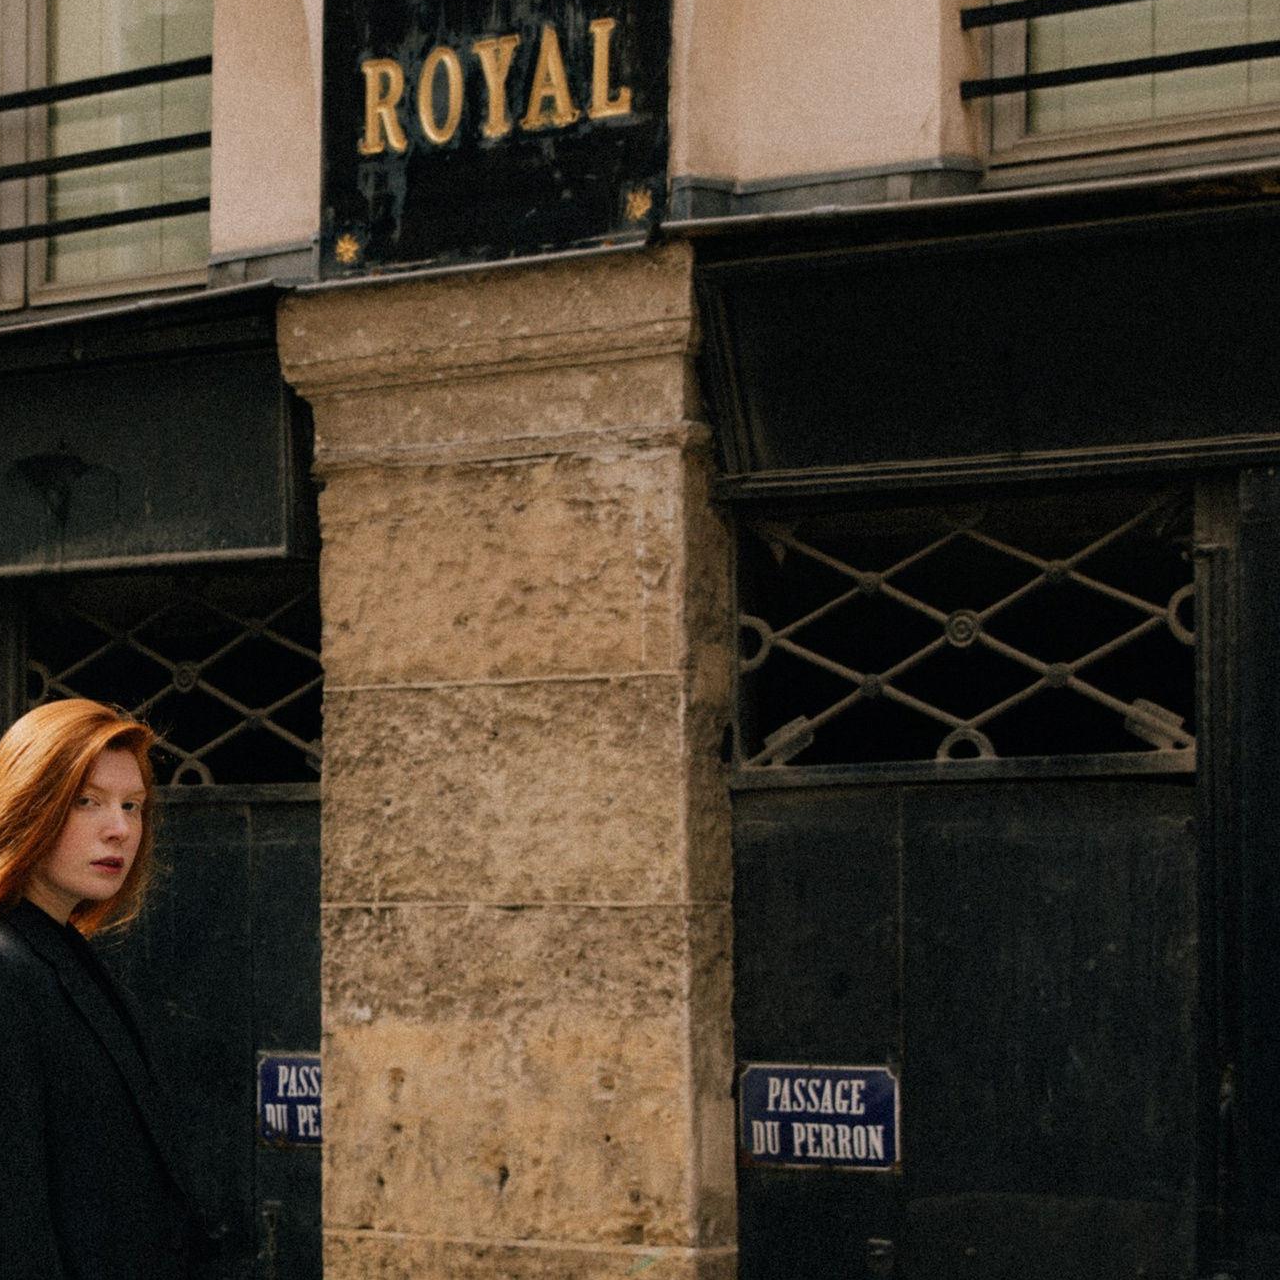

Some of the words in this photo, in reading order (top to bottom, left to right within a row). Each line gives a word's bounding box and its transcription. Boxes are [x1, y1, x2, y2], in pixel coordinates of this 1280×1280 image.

[359, 18, 632, 155] ROYAL
[277, 1065, 322, 1098] PASS
[767, 1077, 866, 1115] PASSAGE
[296, 1104, 322, 1137] PE
[751, 1120, 781, 1155] DU
[791, 1122, 885, 1160] PERRON
